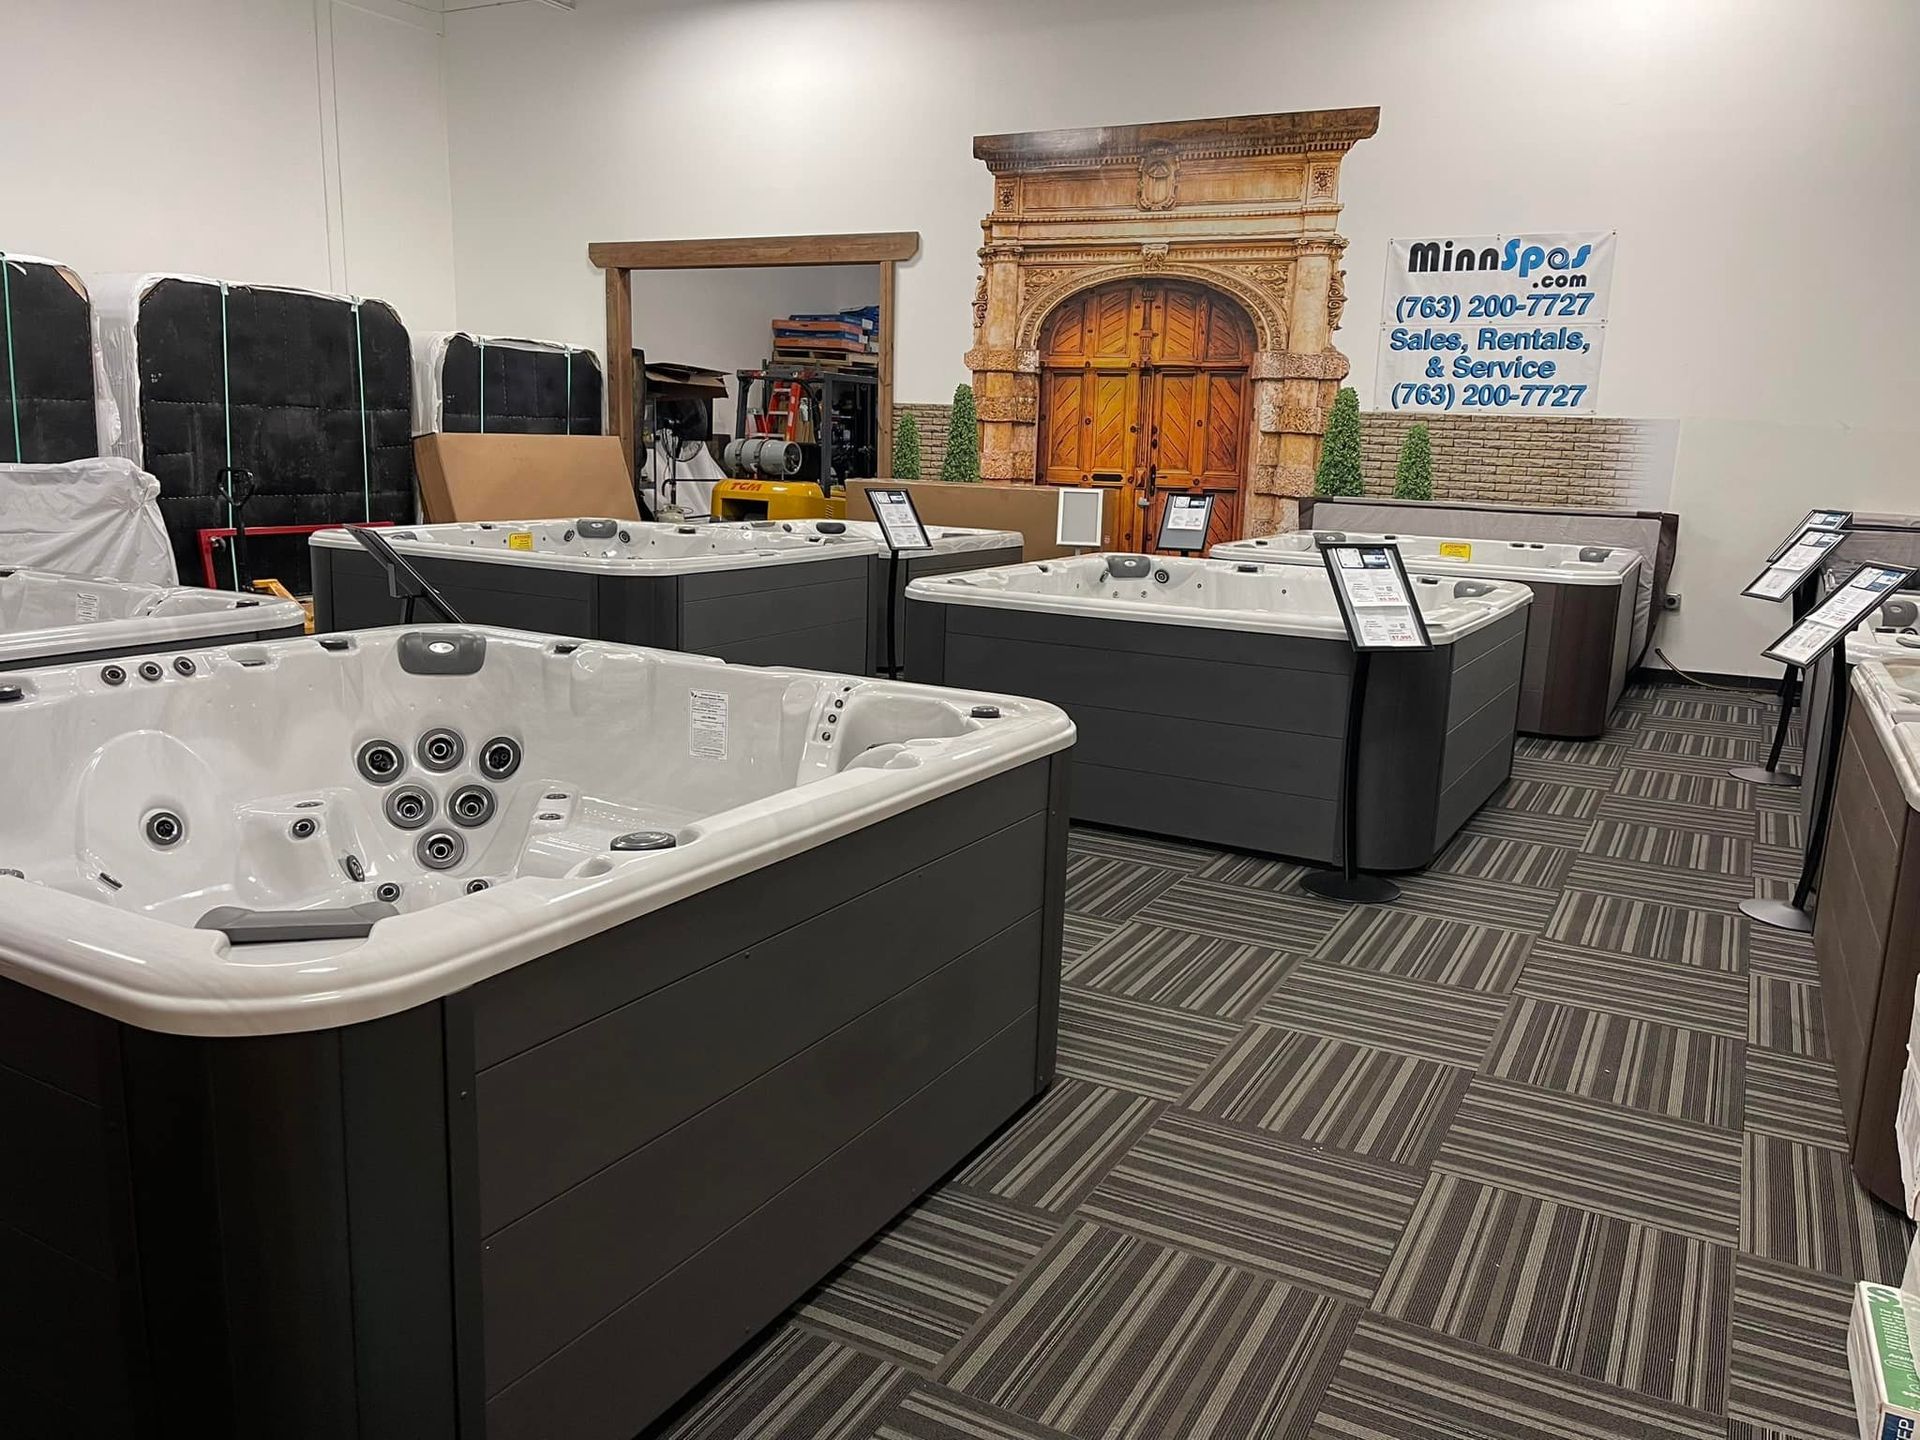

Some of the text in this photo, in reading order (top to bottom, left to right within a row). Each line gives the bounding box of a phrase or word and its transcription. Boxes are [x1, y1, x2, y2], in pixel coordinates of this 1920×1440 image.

[1408, 238, 1592, 277] MinnSpas
[1532, 274, 1587, 288] .com
[1396, 293, 1595, 323] (763) 200-7727
[1390, 327, 1590, 354] Sales, Rentals,
[1425, 355, 1556, 378] & Service
[1391, 382, 1587, 410] (763) 200-7727
